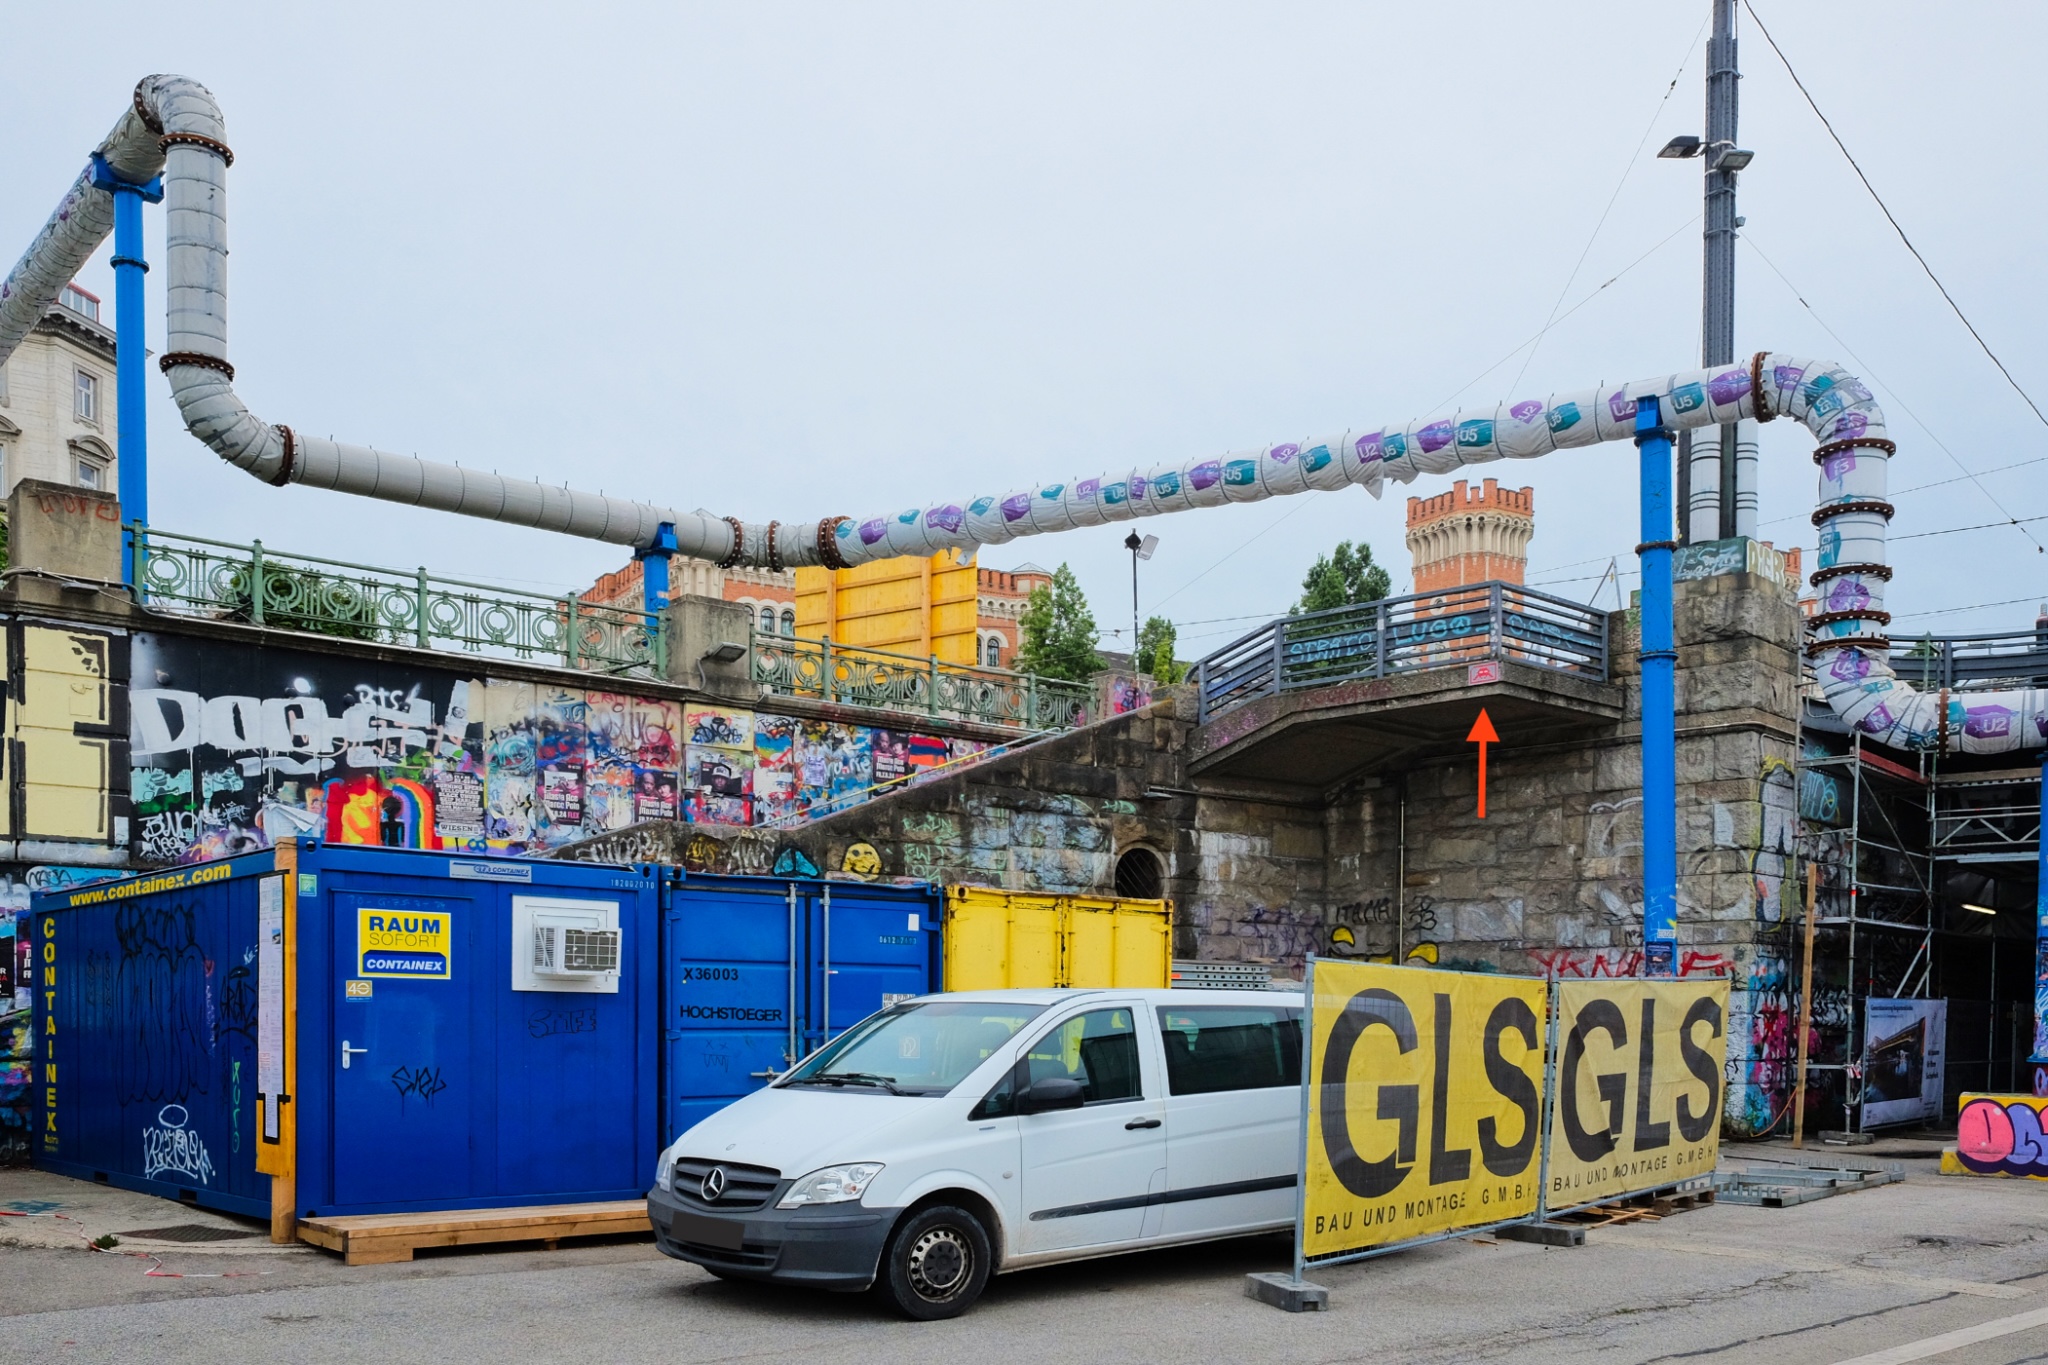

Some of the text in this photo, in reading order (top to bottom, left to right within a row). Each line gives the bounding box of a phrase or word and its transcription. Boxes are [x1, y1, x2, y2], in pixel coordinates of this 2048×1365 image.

[1612, 401, 1635, 417] U2
[1674, 396, 1693, 410] U5
[1549, 412, 1562, 427] U5
[1459, 429, 1477, 442] U5
[1358, 443, 1376, 458] U2
[1303, 456, 1315, 468] U5
[1226, 468, 1242, 481] U5
[1078, 485, 1091, 495] U2
[1112, 488, 1126, 499] U5
[1157, 483, 1171, 495] U5
[1983, 718, 2007, 734] U2
[566, 794, 578, 802] Ace
[661, 801, 672, 809] Ace
[566, 802, 579, 810] Polo
[640, 807, 673, 817] Marco Polo
[493, 867, 530, 876] CONTAINEX
[69, 863, 231, 907] www.containex.com
[369, 916, 440, 934] RAUM
[369, 932, 440, 948] SOFORT
[367, 958, 442, 972] CONTAINEX
[683, 967, 739, 981] X36003
[348, 982, 370, 996] 40
[680, 1005, 782, 1022] HOCHSTOEGER
[43, 918, 57, 1131] CONTAINEX
[1561, 997, 1722, 1163] GLS
[1320, 988, 1539, 1199] GLS
[1554, 1175, 1581, 1191] BAU
[1587, 1167, 1608, 1185] UND
[1612, 1155, 1668, 1178] MONTAGE
[1315, 1212, 1353, 1235] BAU
[1364, 1206, 1397, 1227] UND
[1404, 1192, 1467, 1220] MONTAGE
